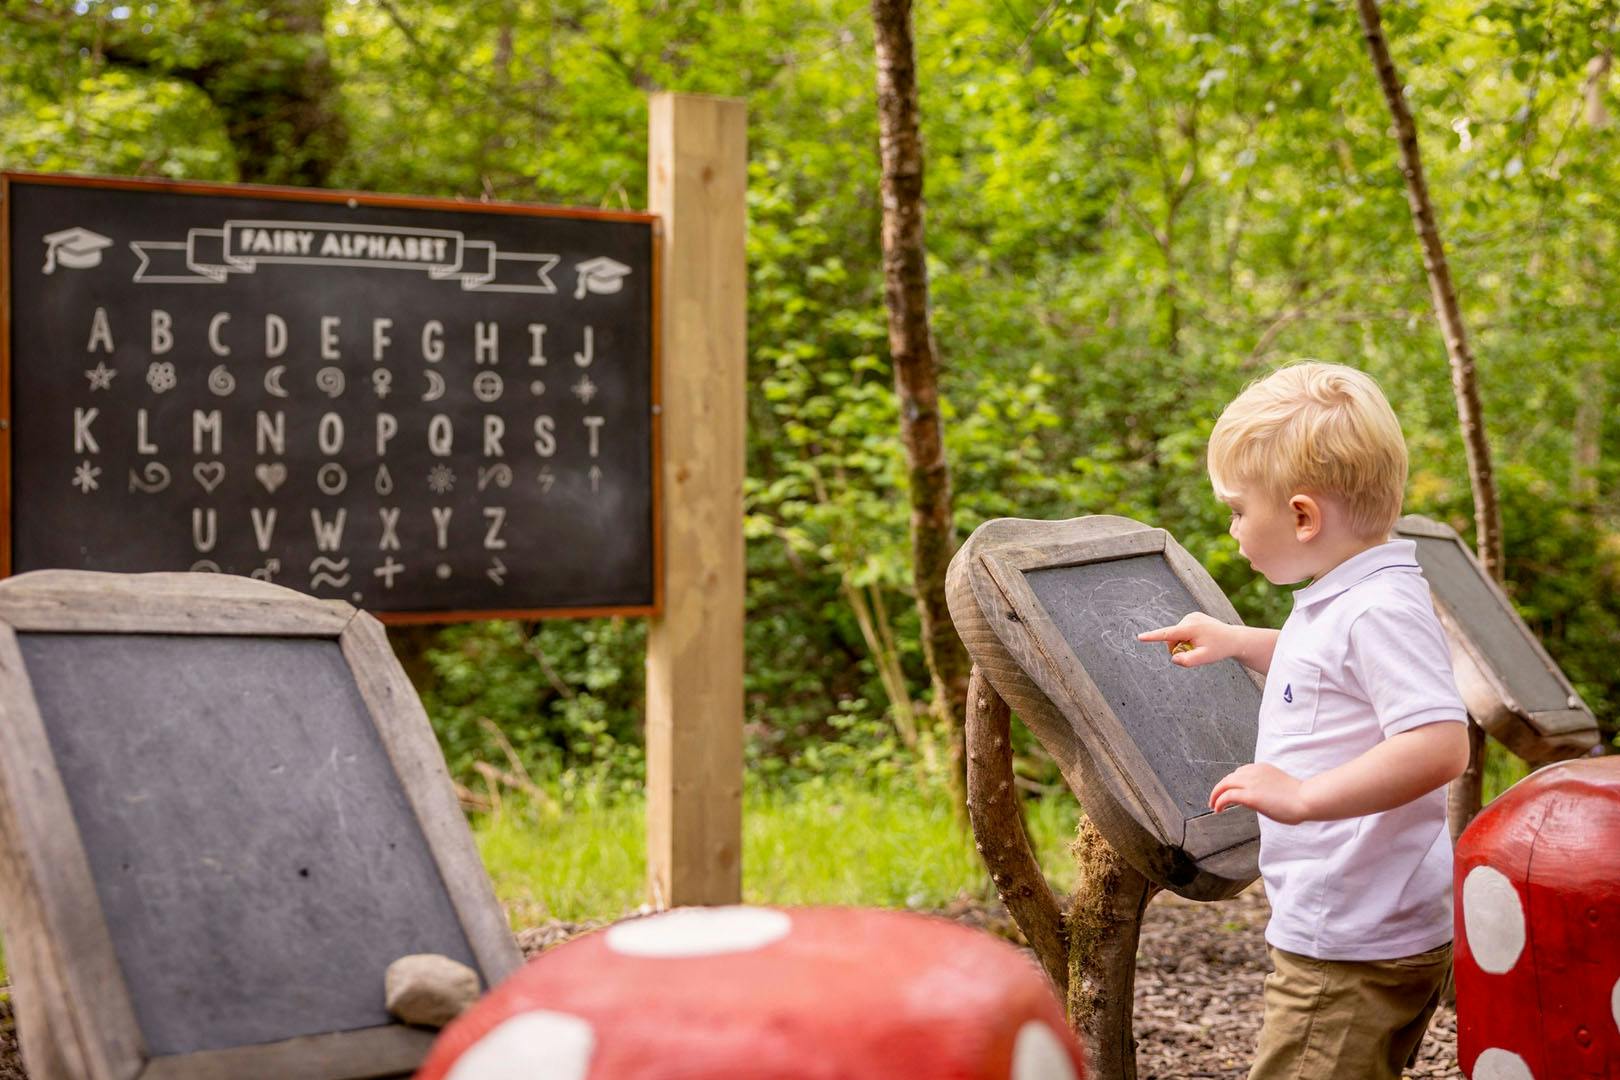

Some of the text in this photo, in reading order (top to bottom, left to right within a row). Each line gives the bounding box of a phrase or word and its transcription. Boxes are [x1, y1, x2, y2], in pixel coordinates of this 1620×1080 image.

[241, 228, 446, 261] FAIRY ALPHABET
[88, 308, 594, 368] A B C D E F G H I J
[74, 408, 605, 458] K L M N O P Q R S T
[192, 508, 506, 552] U V W X Y Z
